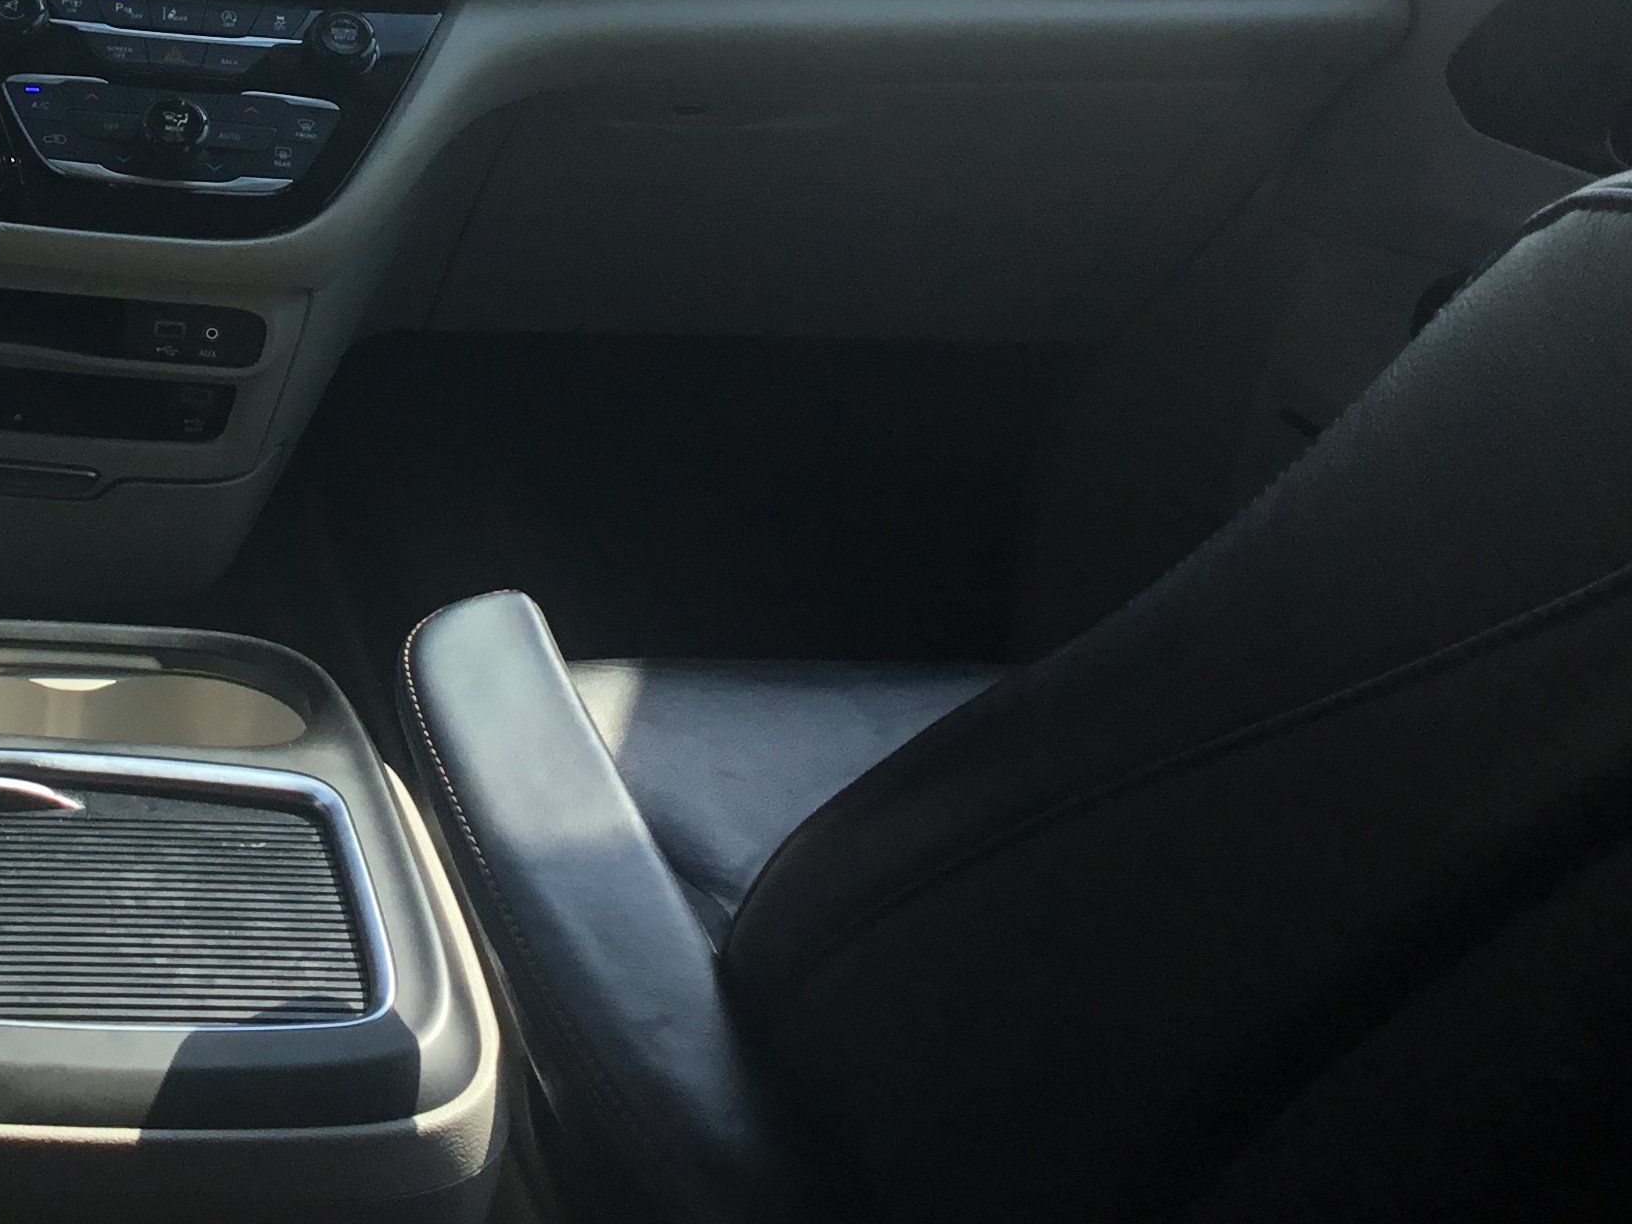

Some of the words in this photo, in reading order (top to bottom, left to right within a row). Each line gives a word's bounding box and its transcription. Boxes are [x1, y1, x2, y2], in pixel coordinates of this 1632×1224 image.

[31, 101, 50, 110] A/C
[219, 132, 241, 141] AUTO
[199, 348, 217, 358] AUX
